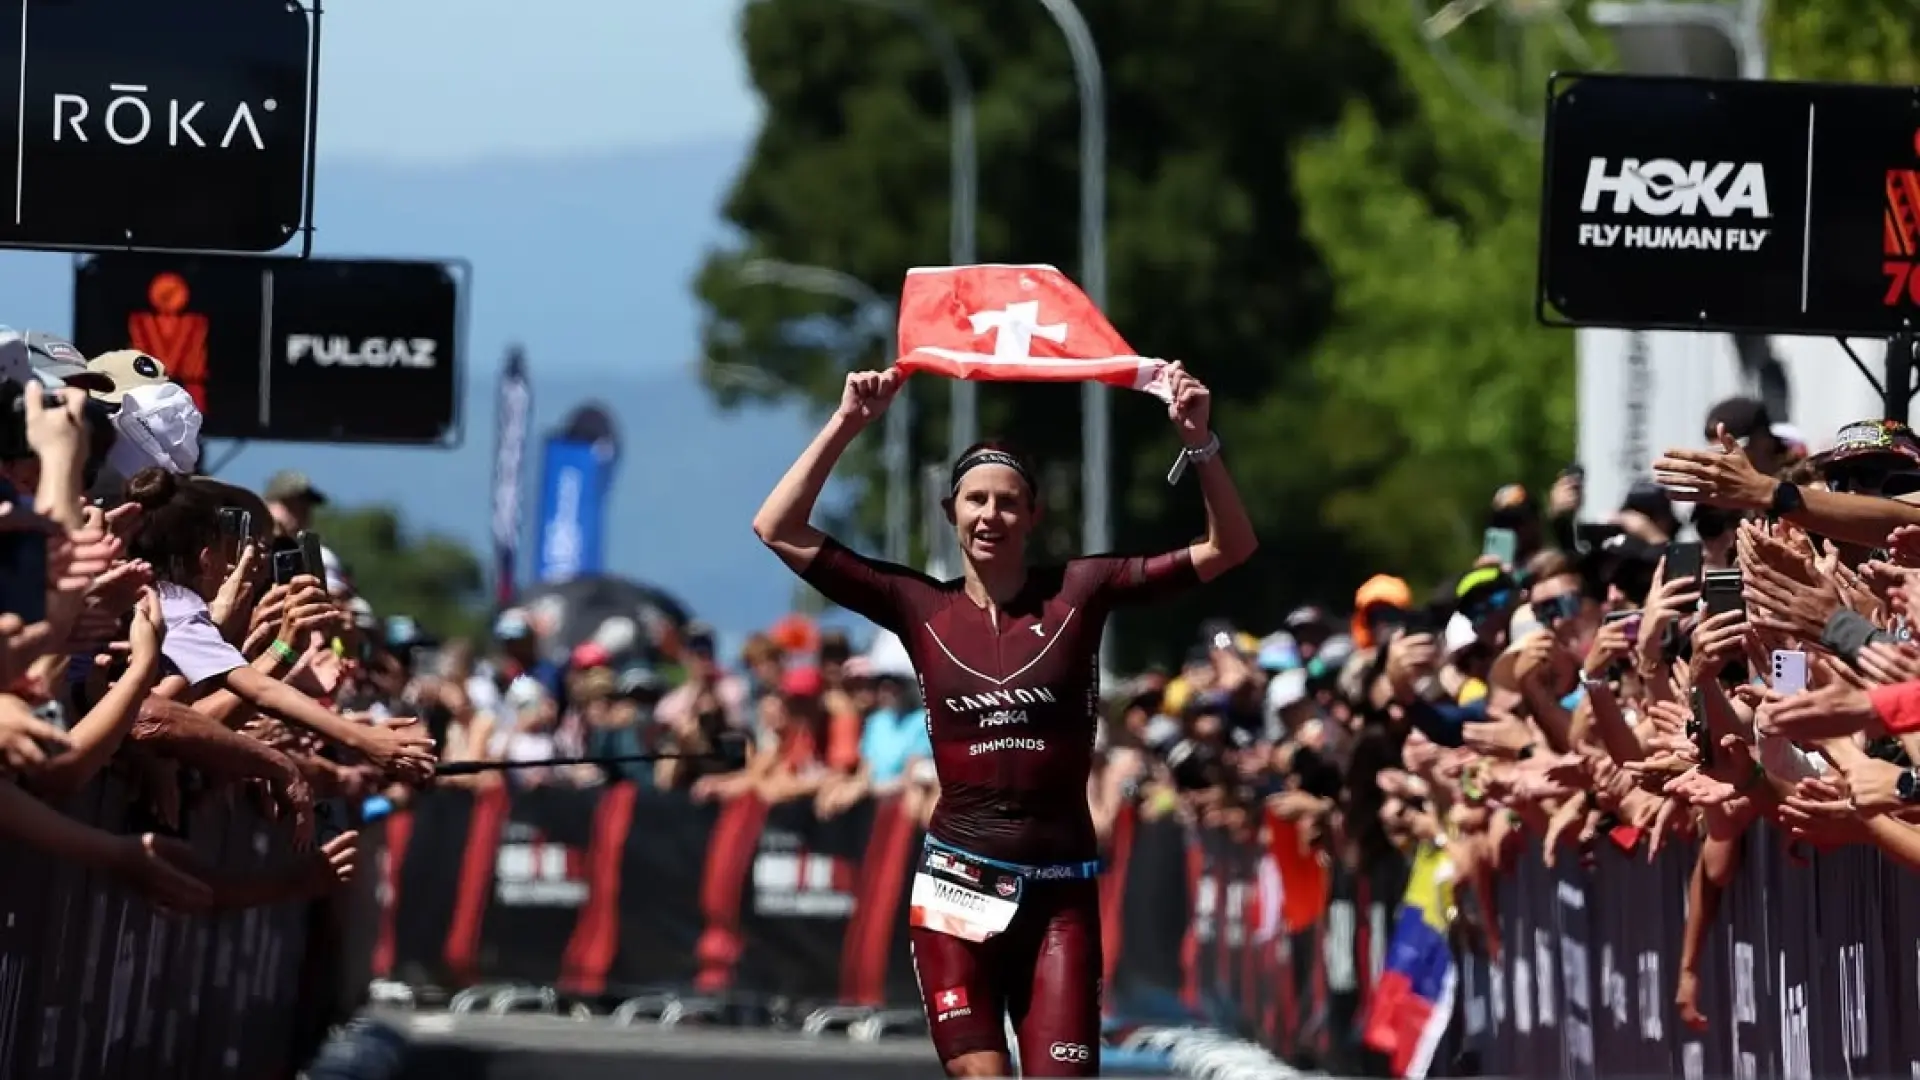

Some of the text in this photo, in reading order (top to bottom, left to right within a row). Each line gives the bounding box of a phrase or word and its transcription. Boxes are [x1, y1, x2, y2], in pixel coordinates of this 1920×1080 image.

[1580, 156, 1769, 218] HOKA
[1578, 223, 1769, 251] FLY HUMAN FLY
[286, 334, 437, 369] FULGAZ
[945, 687, 1057, 712] CANYON
[979, 710, 1029, 728] HOKA
[969, 737, 1046, 756] SIMMONDS
